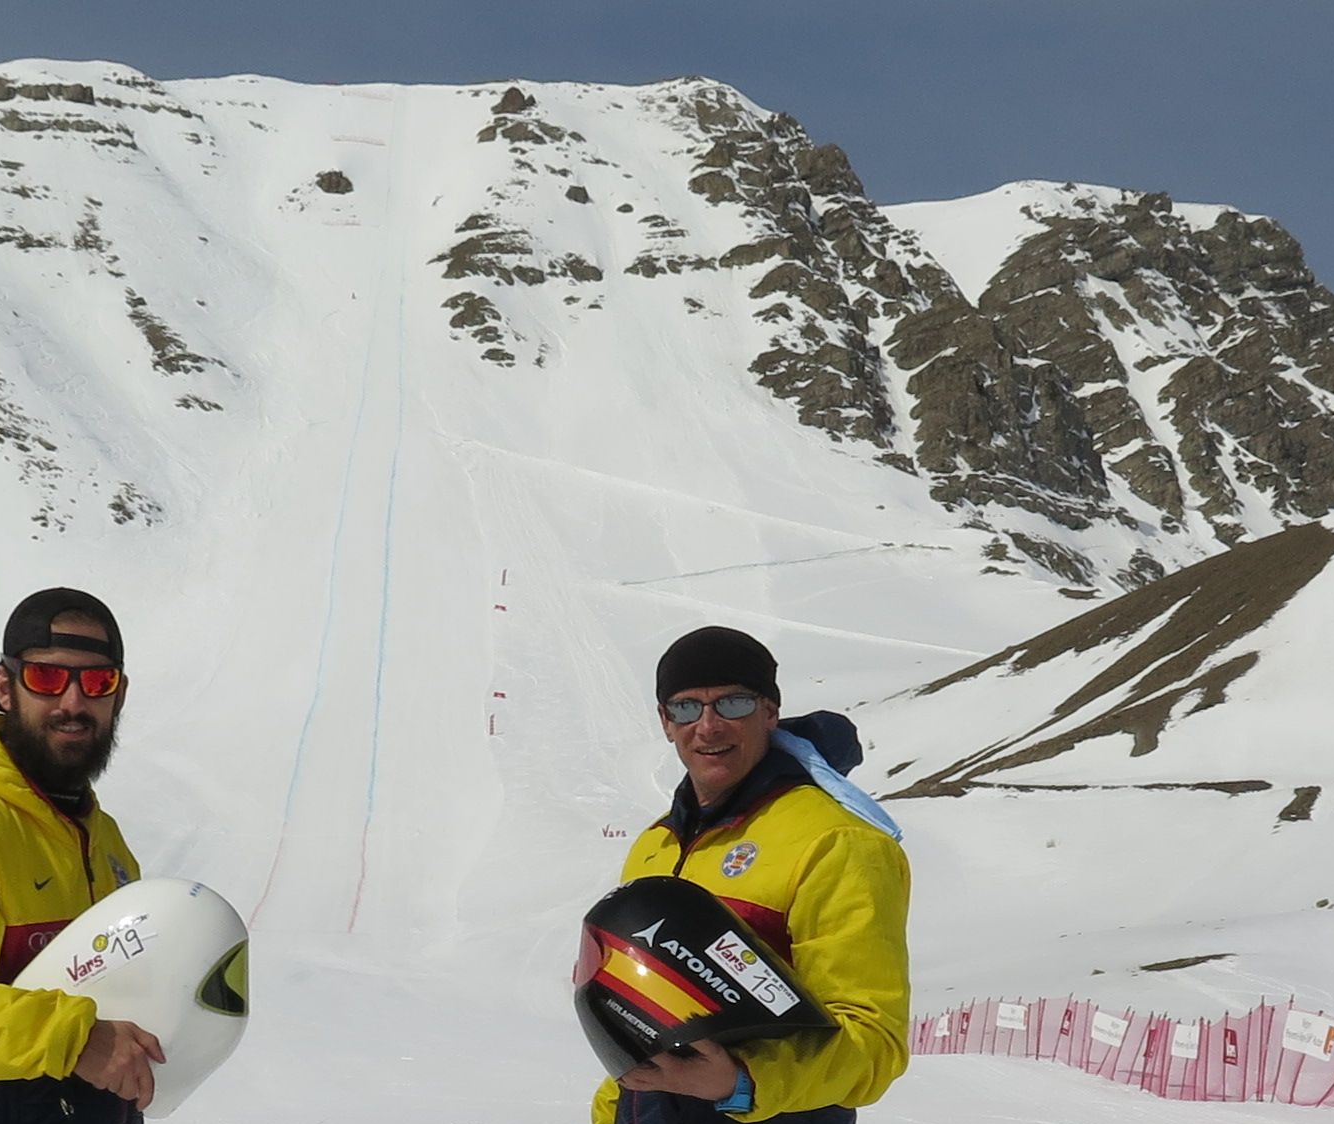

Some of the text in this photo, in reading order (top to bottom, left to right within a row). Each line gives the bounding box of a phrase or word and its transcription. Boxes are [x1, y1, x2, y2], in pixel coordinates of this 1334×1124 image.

[602, 823, 627, 838] Vars
[110, 928, 144, 960] 19
[714, 938, 748, 973] Vars
[66, 954, 104, 981] Vars
[659, 939, 741, 1004] ATOMIC
[751, 975, 776, 1004] 15
